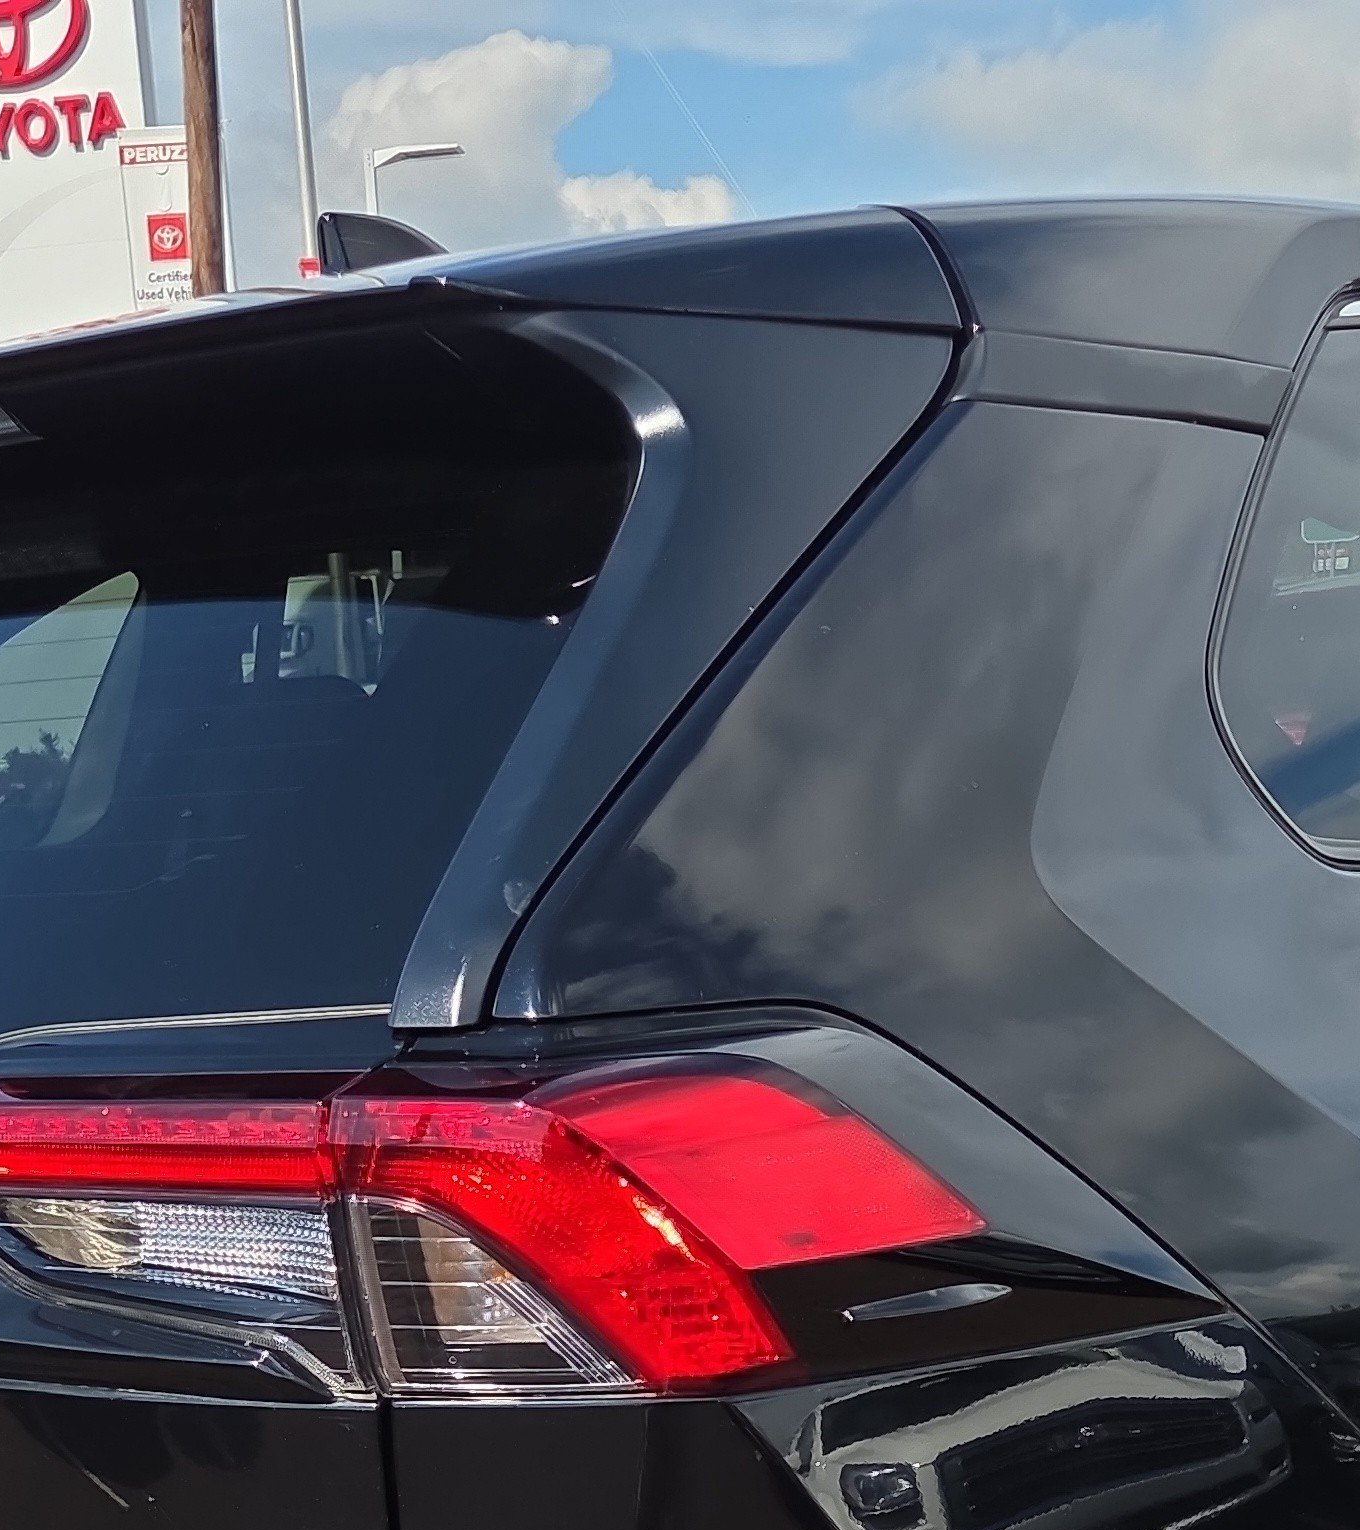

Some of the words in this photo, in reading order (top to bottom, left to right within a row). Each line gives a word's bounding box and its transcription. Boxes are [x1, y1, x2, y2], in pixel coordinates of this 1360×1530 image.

[123, 144, 188, 164] PERUZ
[148, 270, 192, 283] Certifie
[137, 289, 164, 300] Used
[166, 287, 192, 301] Vehi
